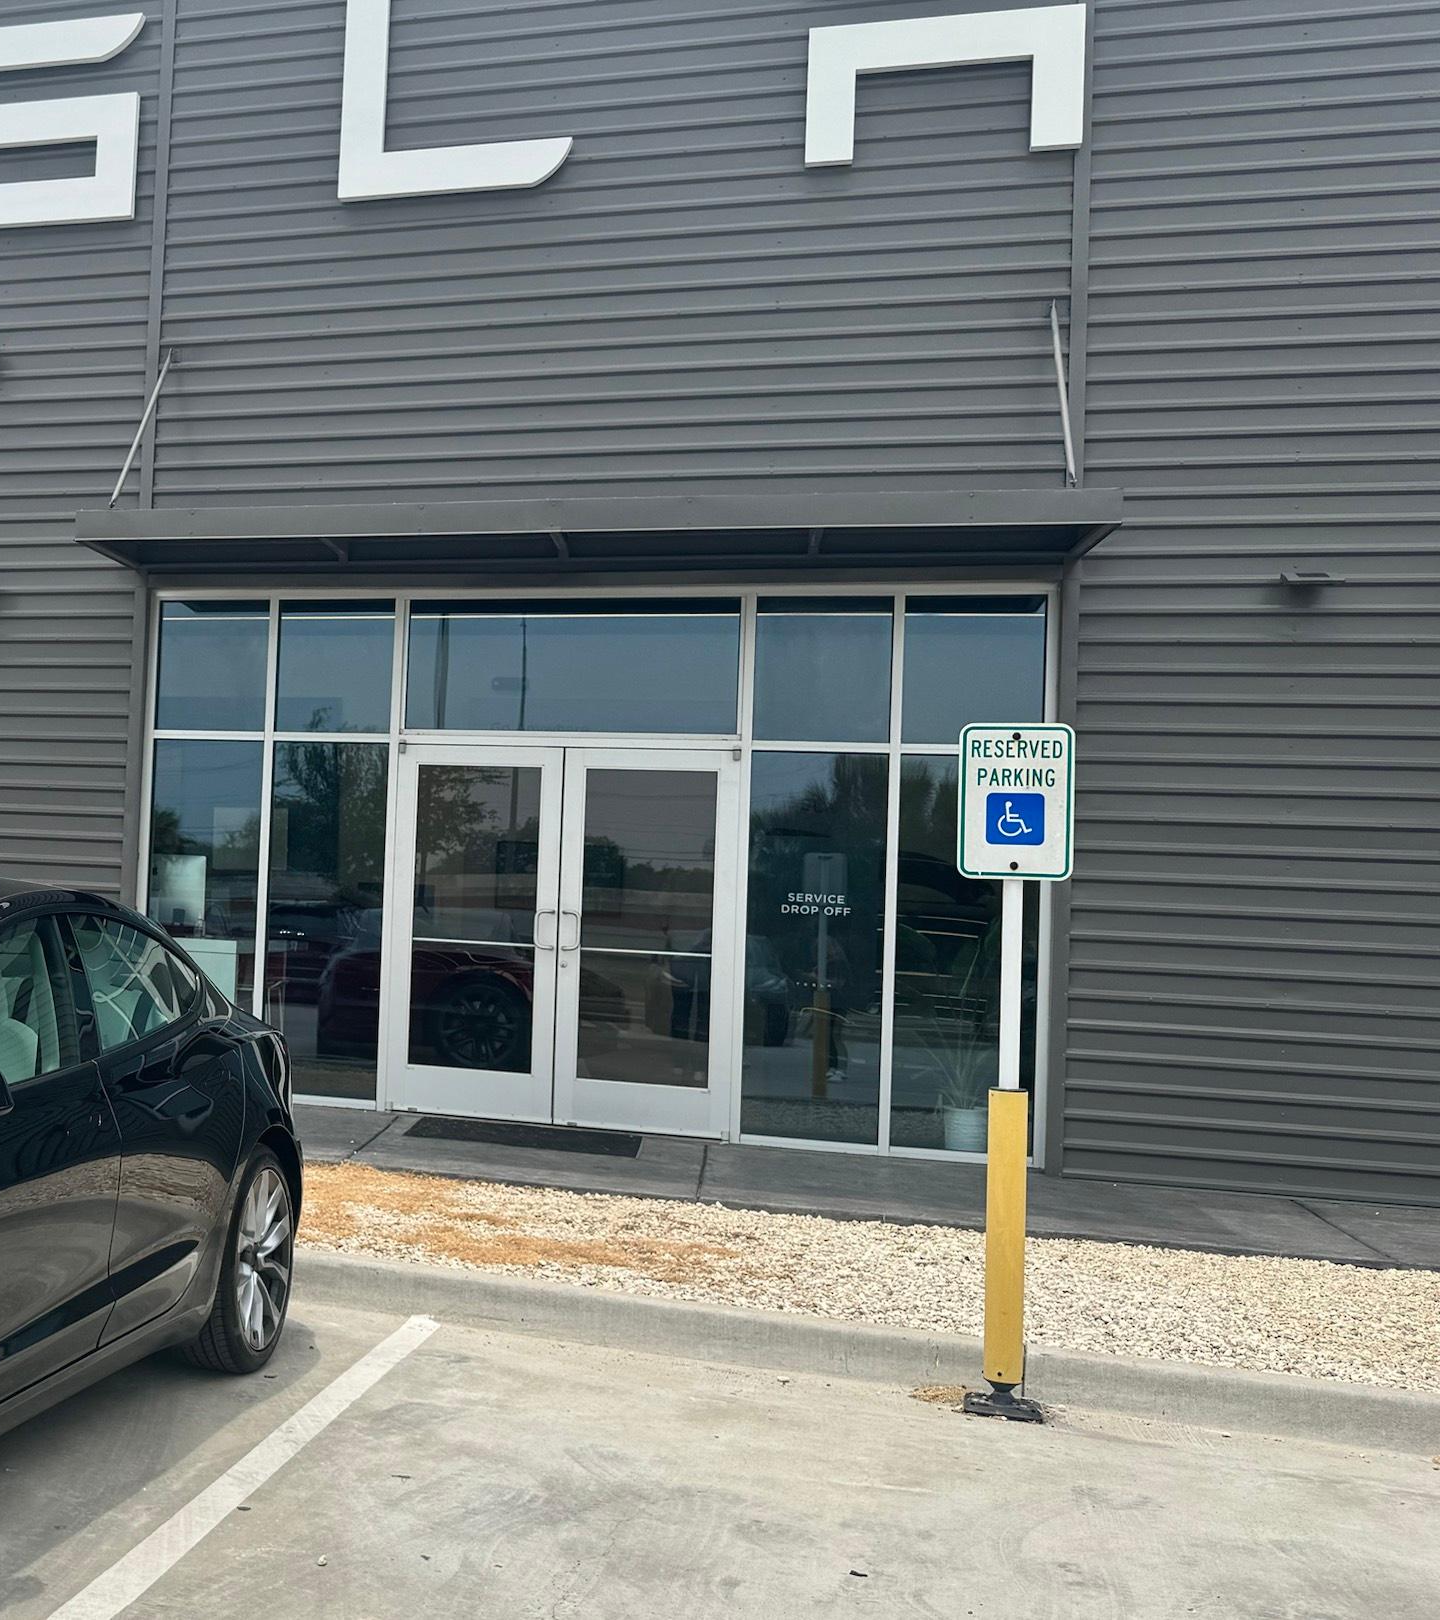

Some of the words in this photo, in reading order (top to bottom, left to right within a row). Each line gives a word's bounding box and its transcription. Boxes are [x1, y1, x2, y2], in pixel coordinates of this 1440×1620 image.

[971, 739, 1063, 759] RESERVED
[977, 767, 1056, 787] PARKING
[787, 892, 846, 905] SERVICE
[781, 904, 819, 915] DROP
[823, 906, 852, 917] OFF
